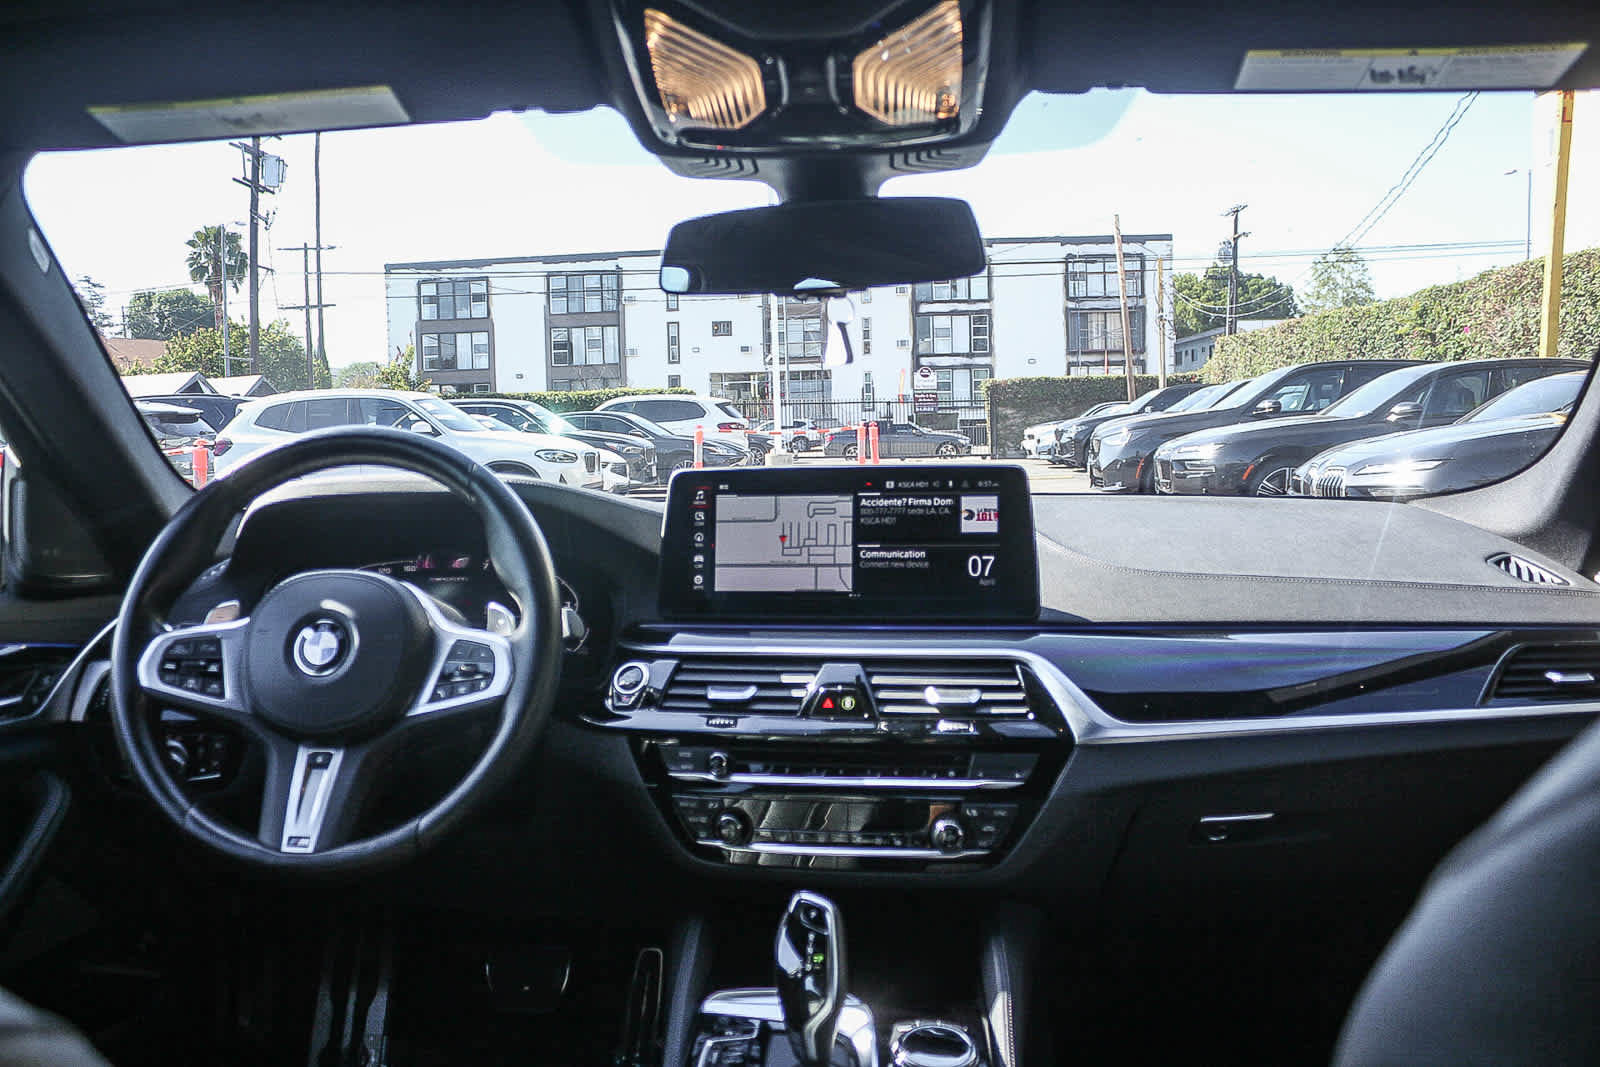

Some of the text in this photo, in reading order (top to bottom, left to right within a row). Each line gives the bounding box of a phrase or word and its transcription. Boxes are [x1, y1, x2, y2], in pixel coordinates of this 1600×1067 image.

[860, 498, 907, 506] Accidente?
[908, 497, 932, 506] Firma
[860, 550, 926, 558] Communication
[968, 556, 995, 576] 07
